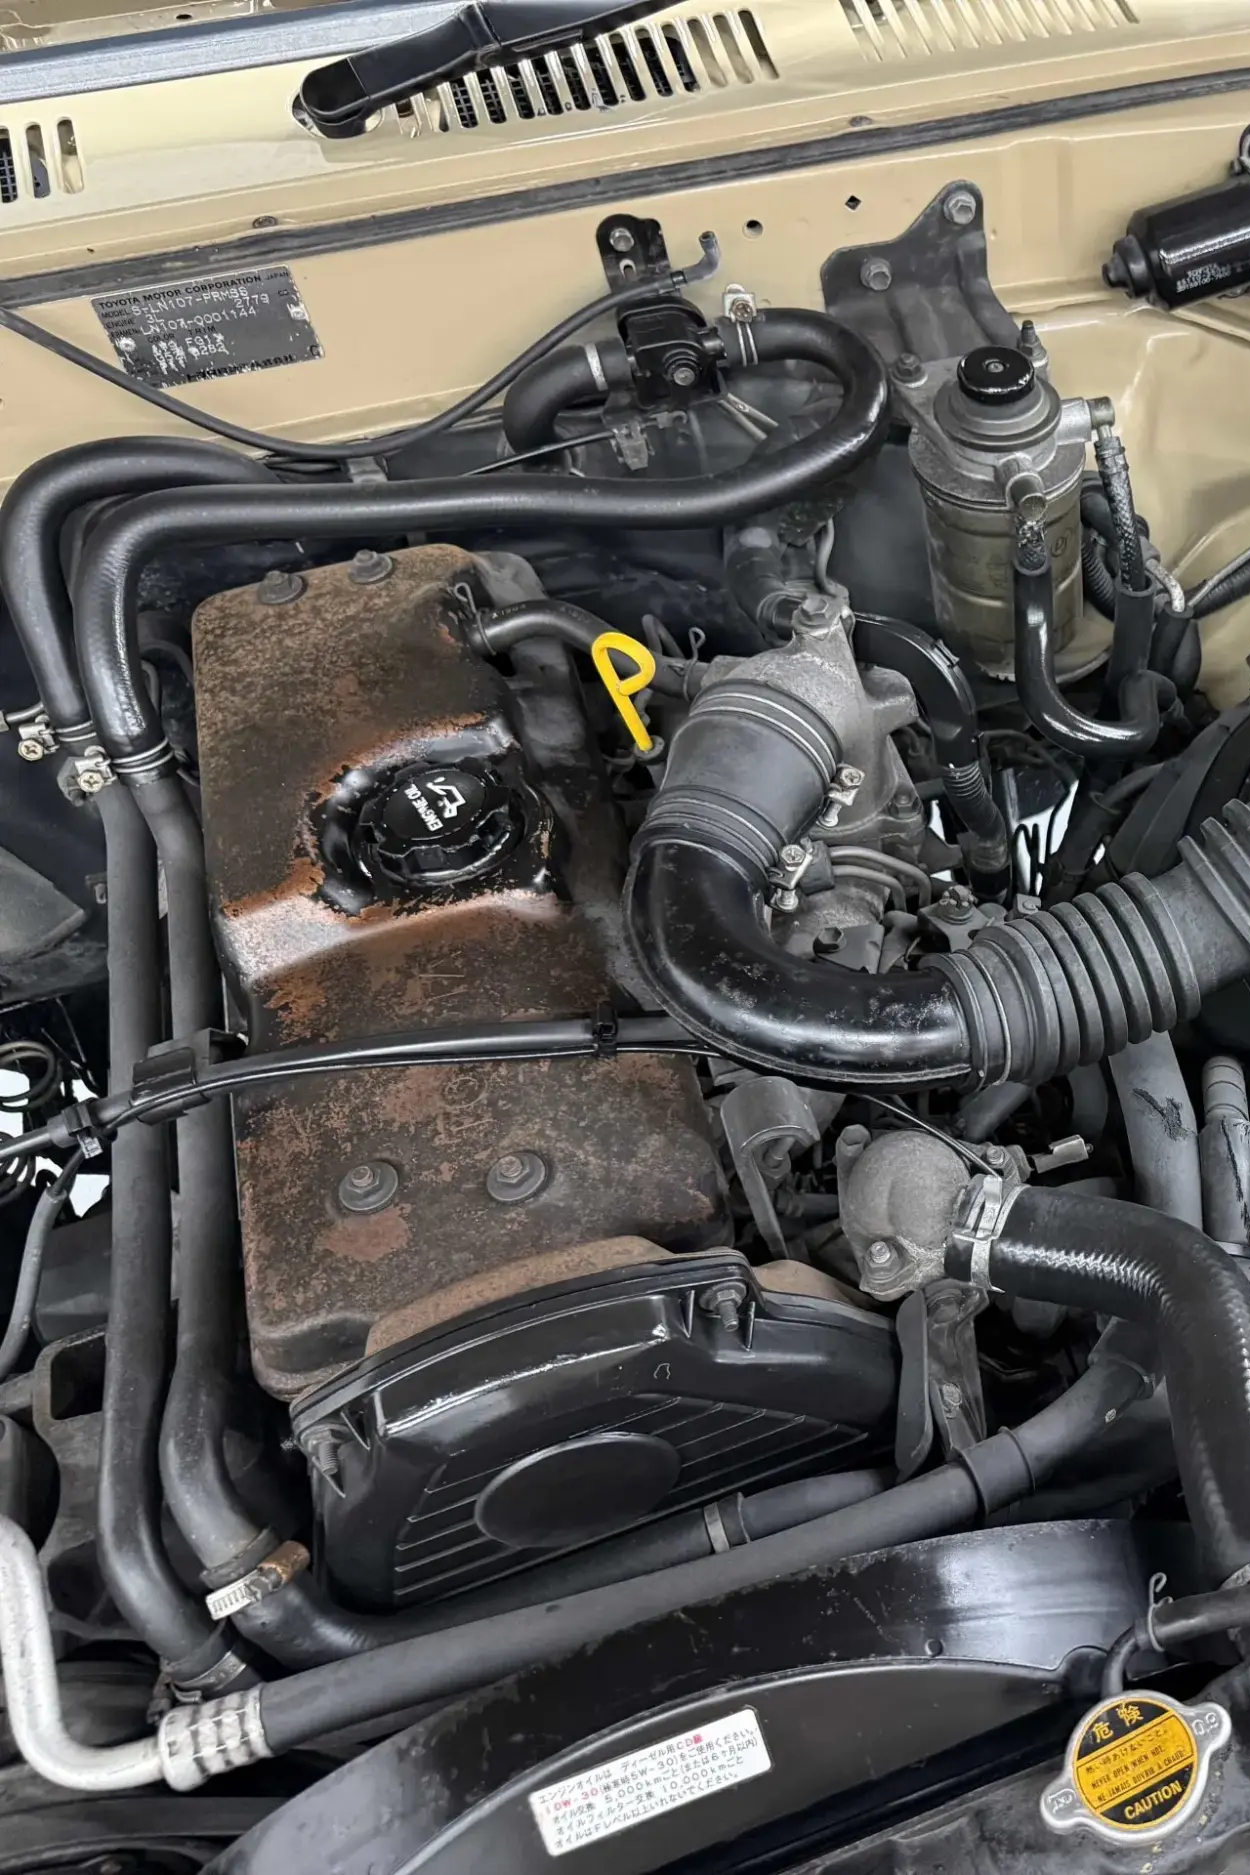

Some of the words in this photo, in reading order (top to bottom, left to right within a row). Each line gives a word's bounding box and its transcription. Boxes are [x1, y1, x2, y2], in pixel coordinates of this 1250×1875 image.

[98, 297, 140, 309] TOYOTA
[143, 289, 181, 302] MOTOR
[185, 275, 262, 294] CORPORATION
[147, 314, 164, 324] 3L
[188, 326, 216, 335] TRIM
[404, 784, 421, 800] OIL
[412, 796, 443, 832] ENGINE
[1092, 1703, 1144, 1743] 危険
[1091, 1775, 1111, 1790] NEVER
[1113, 1765, 1130, 1778] OPEN
[1132, 1755, 1149, 1770] WHEN
[1097, 1793, 1106, 1802] NE
[1108, 1780, 1130, 1797] JAMAIS
[1133, 1768, 1155, 1785] OUVRIR
[1124, 1780, 1183, 1820] CAUTION
